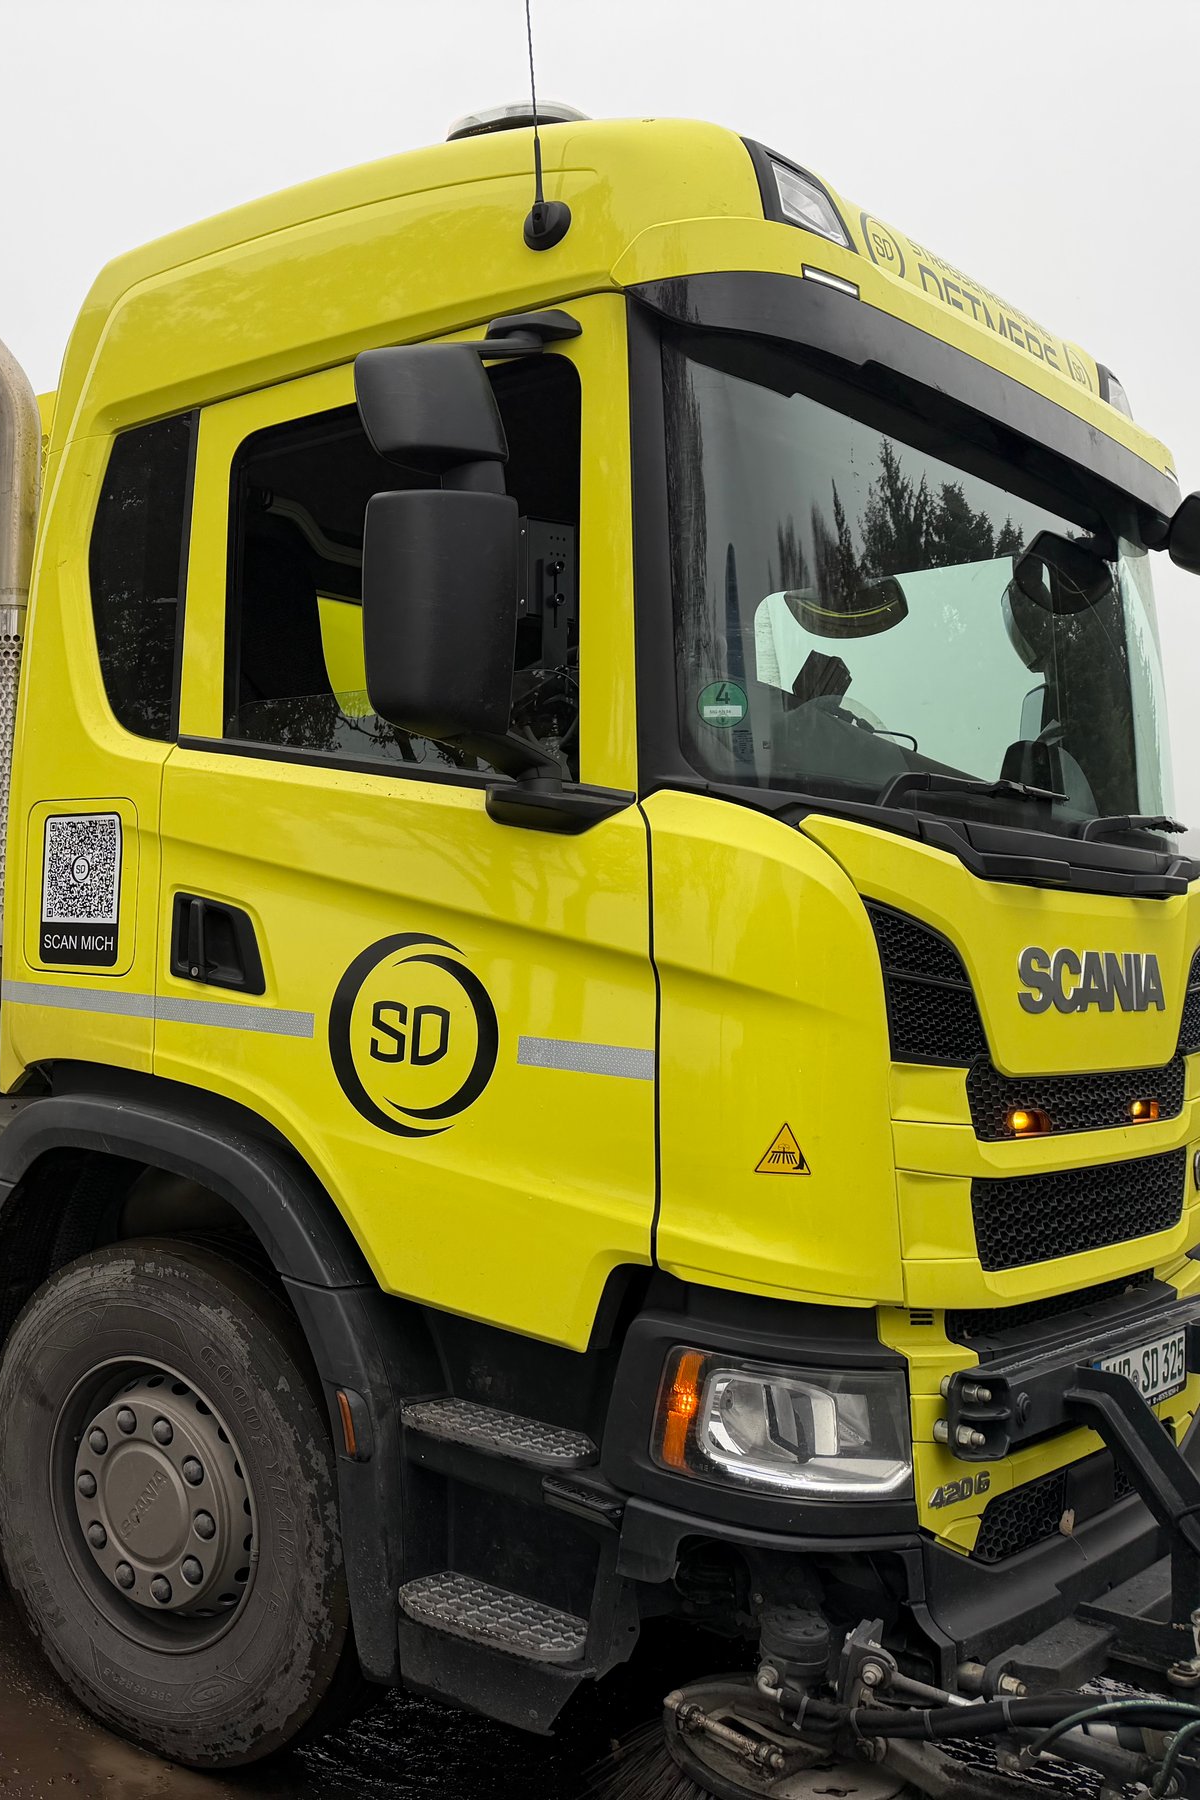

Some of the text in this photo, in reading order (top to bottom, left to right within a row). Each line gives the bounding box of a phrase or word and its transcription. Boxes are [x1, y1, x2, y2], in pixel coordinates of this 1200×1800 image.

[872, 233, 894, 261] SD
[715, 683, 731, 705] 4
[43, 934, 114, 951] SCAN MICH
[1017, 946, 1166, 1014] SCANIA
[370, 1000, 451, 1066] SD
[1142, 1347, 1159, 1393] SD
[1162, 1336, 1184, 1383] 325
